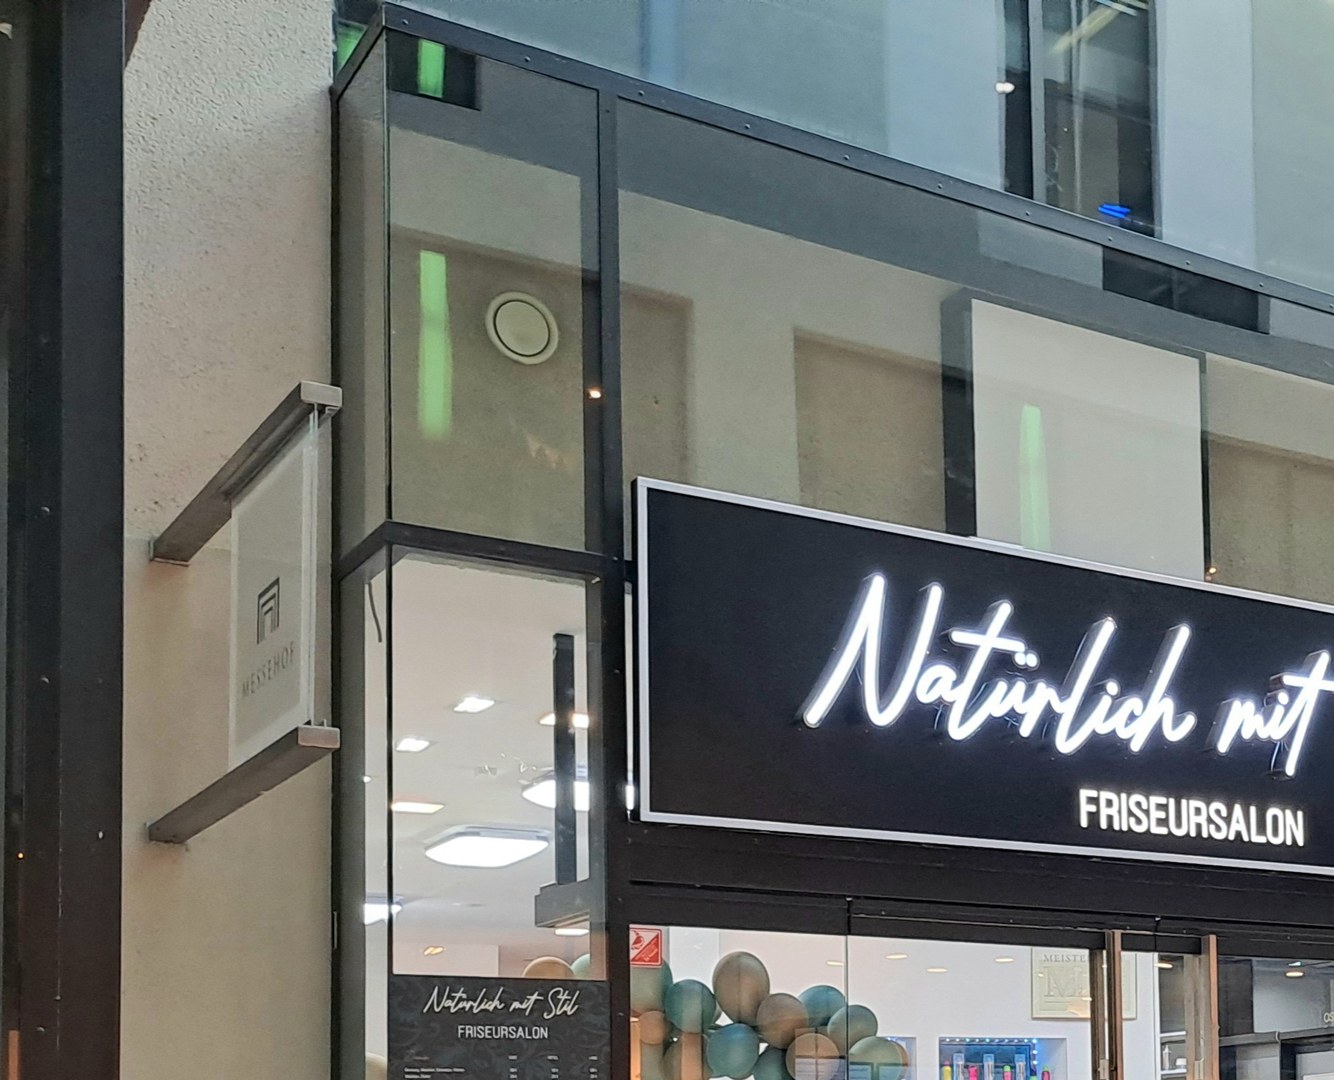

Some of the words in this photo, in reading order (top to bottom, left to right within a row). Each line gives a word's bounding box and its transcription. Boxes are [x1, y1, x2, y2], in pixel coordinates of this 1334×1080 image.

[241, 641, 295, 698] MESSEHOF
[804, 573, 1196, 754] Natürlich
[1079, 787, 1306, 848] FRISEURSALON
[509, 991, 544, 1016] mit
[543, 986, 580, 1020] Stil
[457, 1024, 549, 1040] FRISEURSALON
